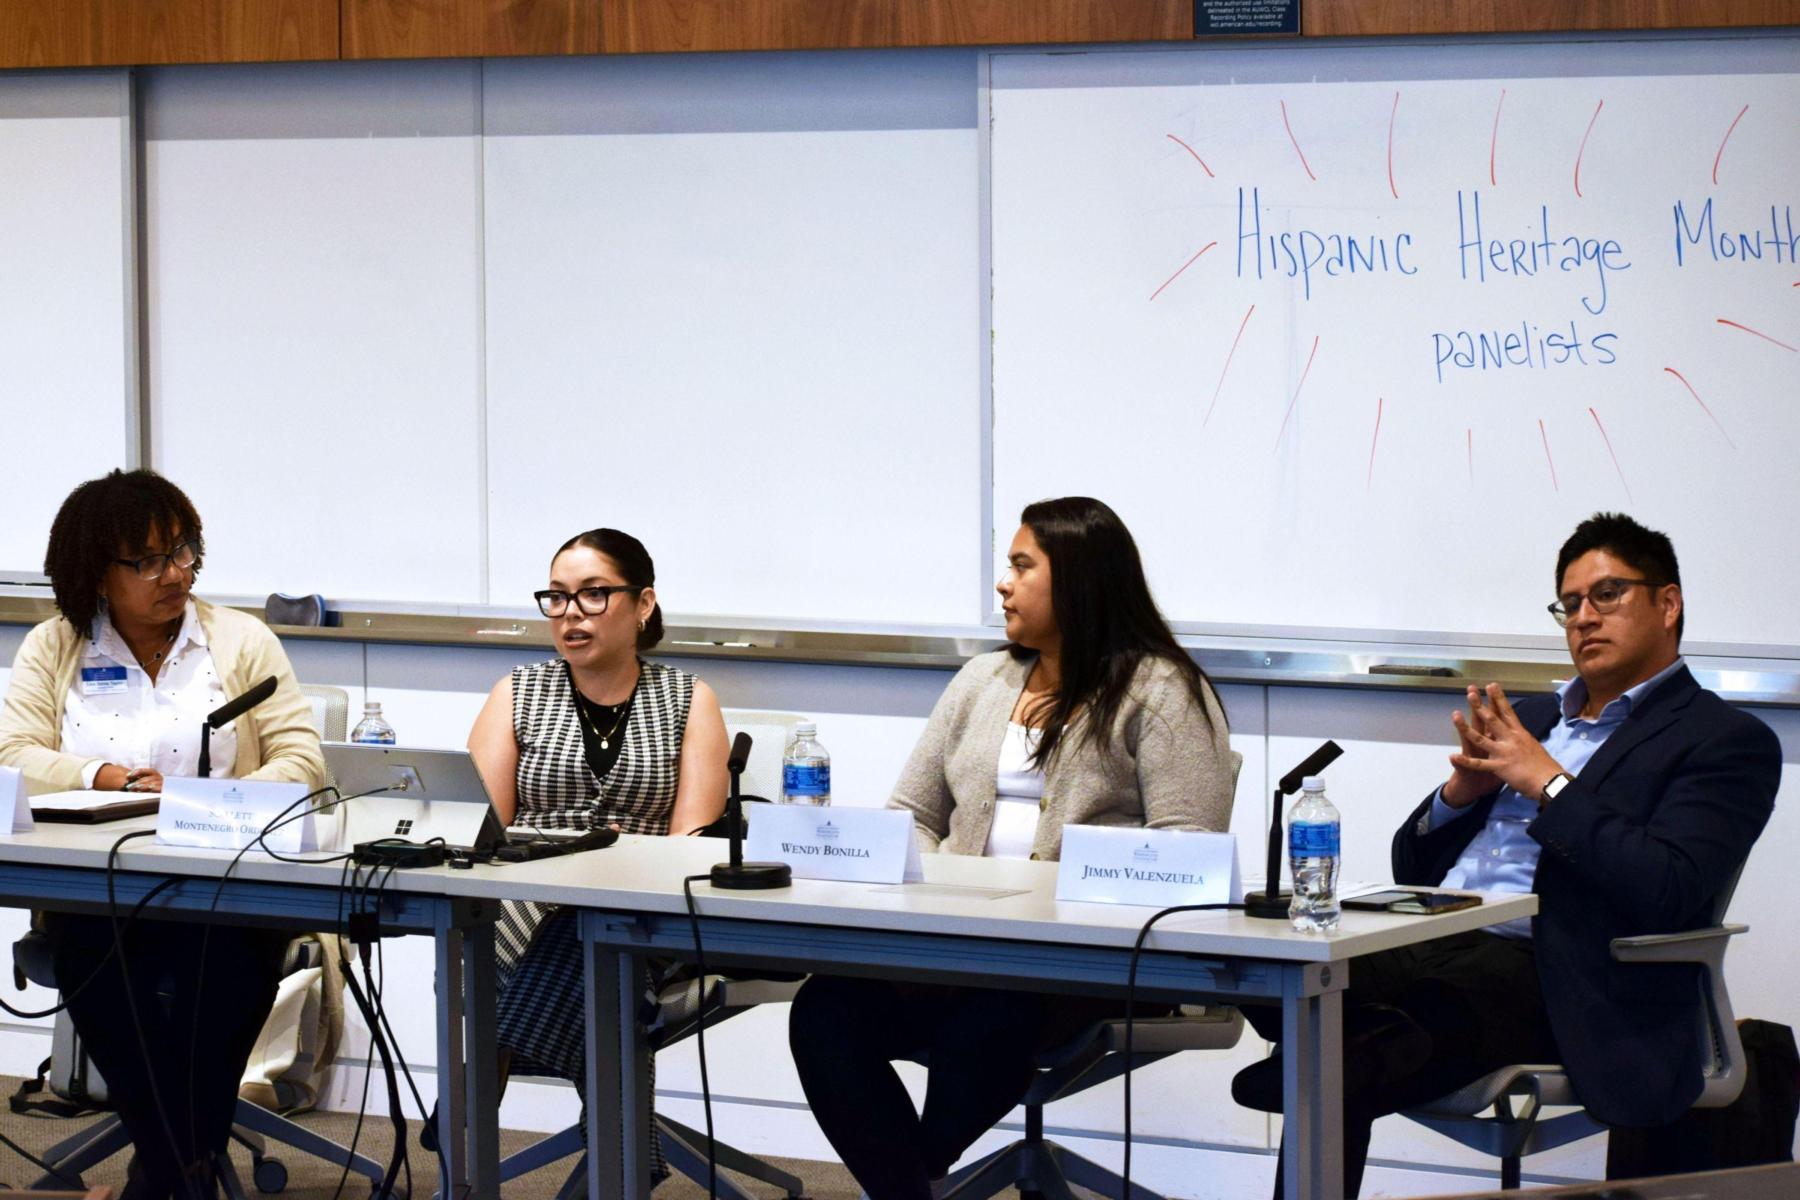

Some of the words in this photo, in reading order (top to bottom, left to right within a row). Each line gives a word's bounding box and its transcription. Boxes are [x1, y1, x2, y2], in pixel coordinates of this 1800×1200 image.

[1237, 187, 1418, 300] Hispanic
[1458, 190, 1632, 315] Heritage
[1432, 320, 1618, 384] panelists
[781, 842, 822, 856] WENDY
[823, 845, 870, 858] BONILLA
[1081, 864, 1122, 879] JIMMY
[1123, 867, 1205, 885] VALENZUELA
